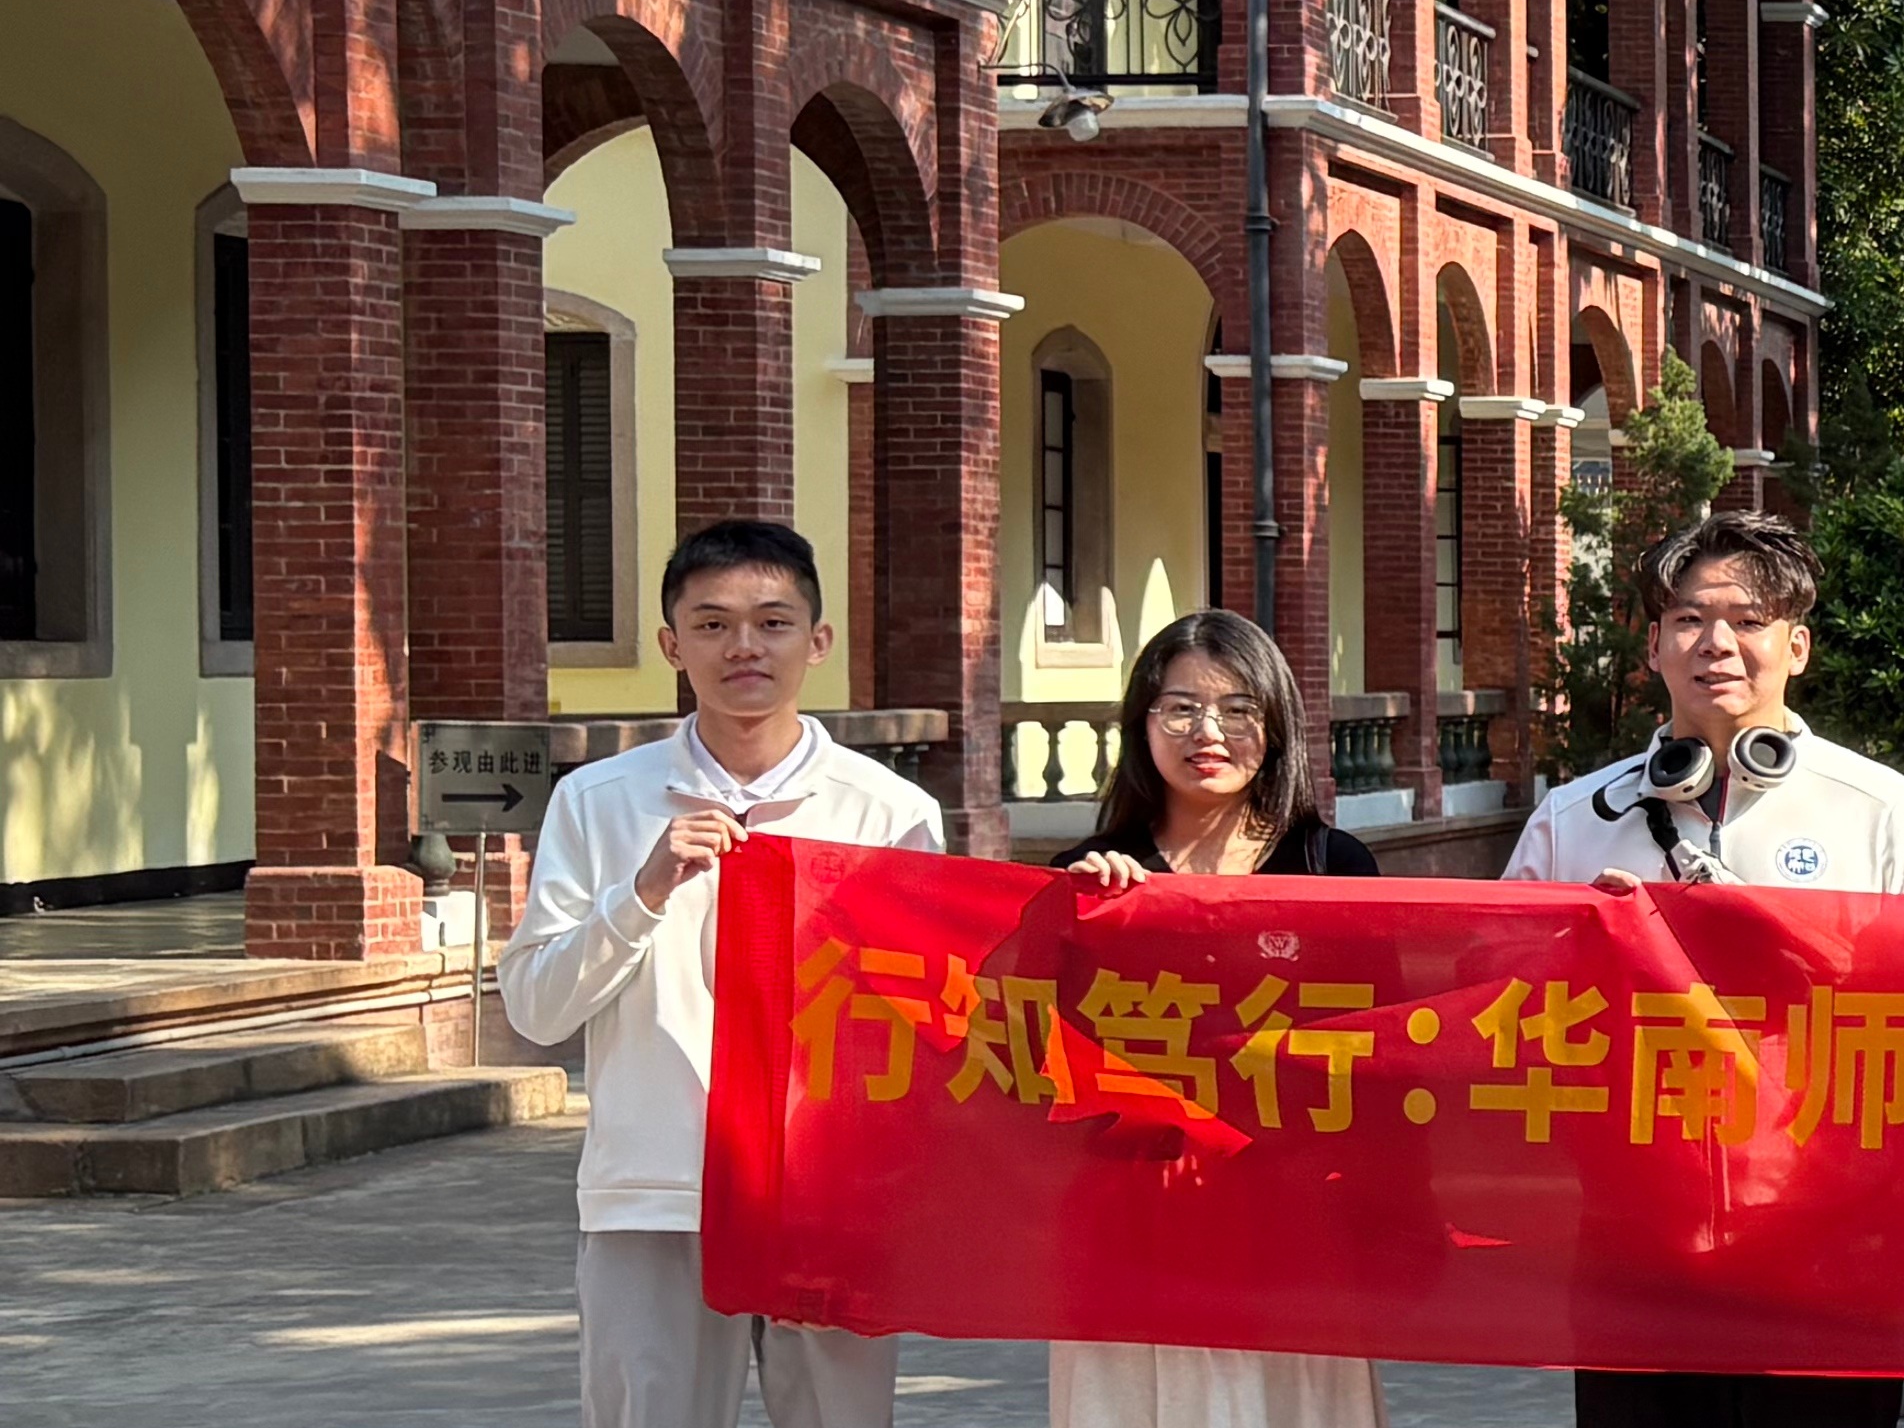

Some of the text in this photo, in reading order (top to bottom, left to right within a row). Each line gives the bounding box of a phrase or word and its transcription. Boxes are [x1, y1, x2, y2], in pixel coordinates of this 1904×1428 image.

[429, 749, 541, 775] 参观由此进
